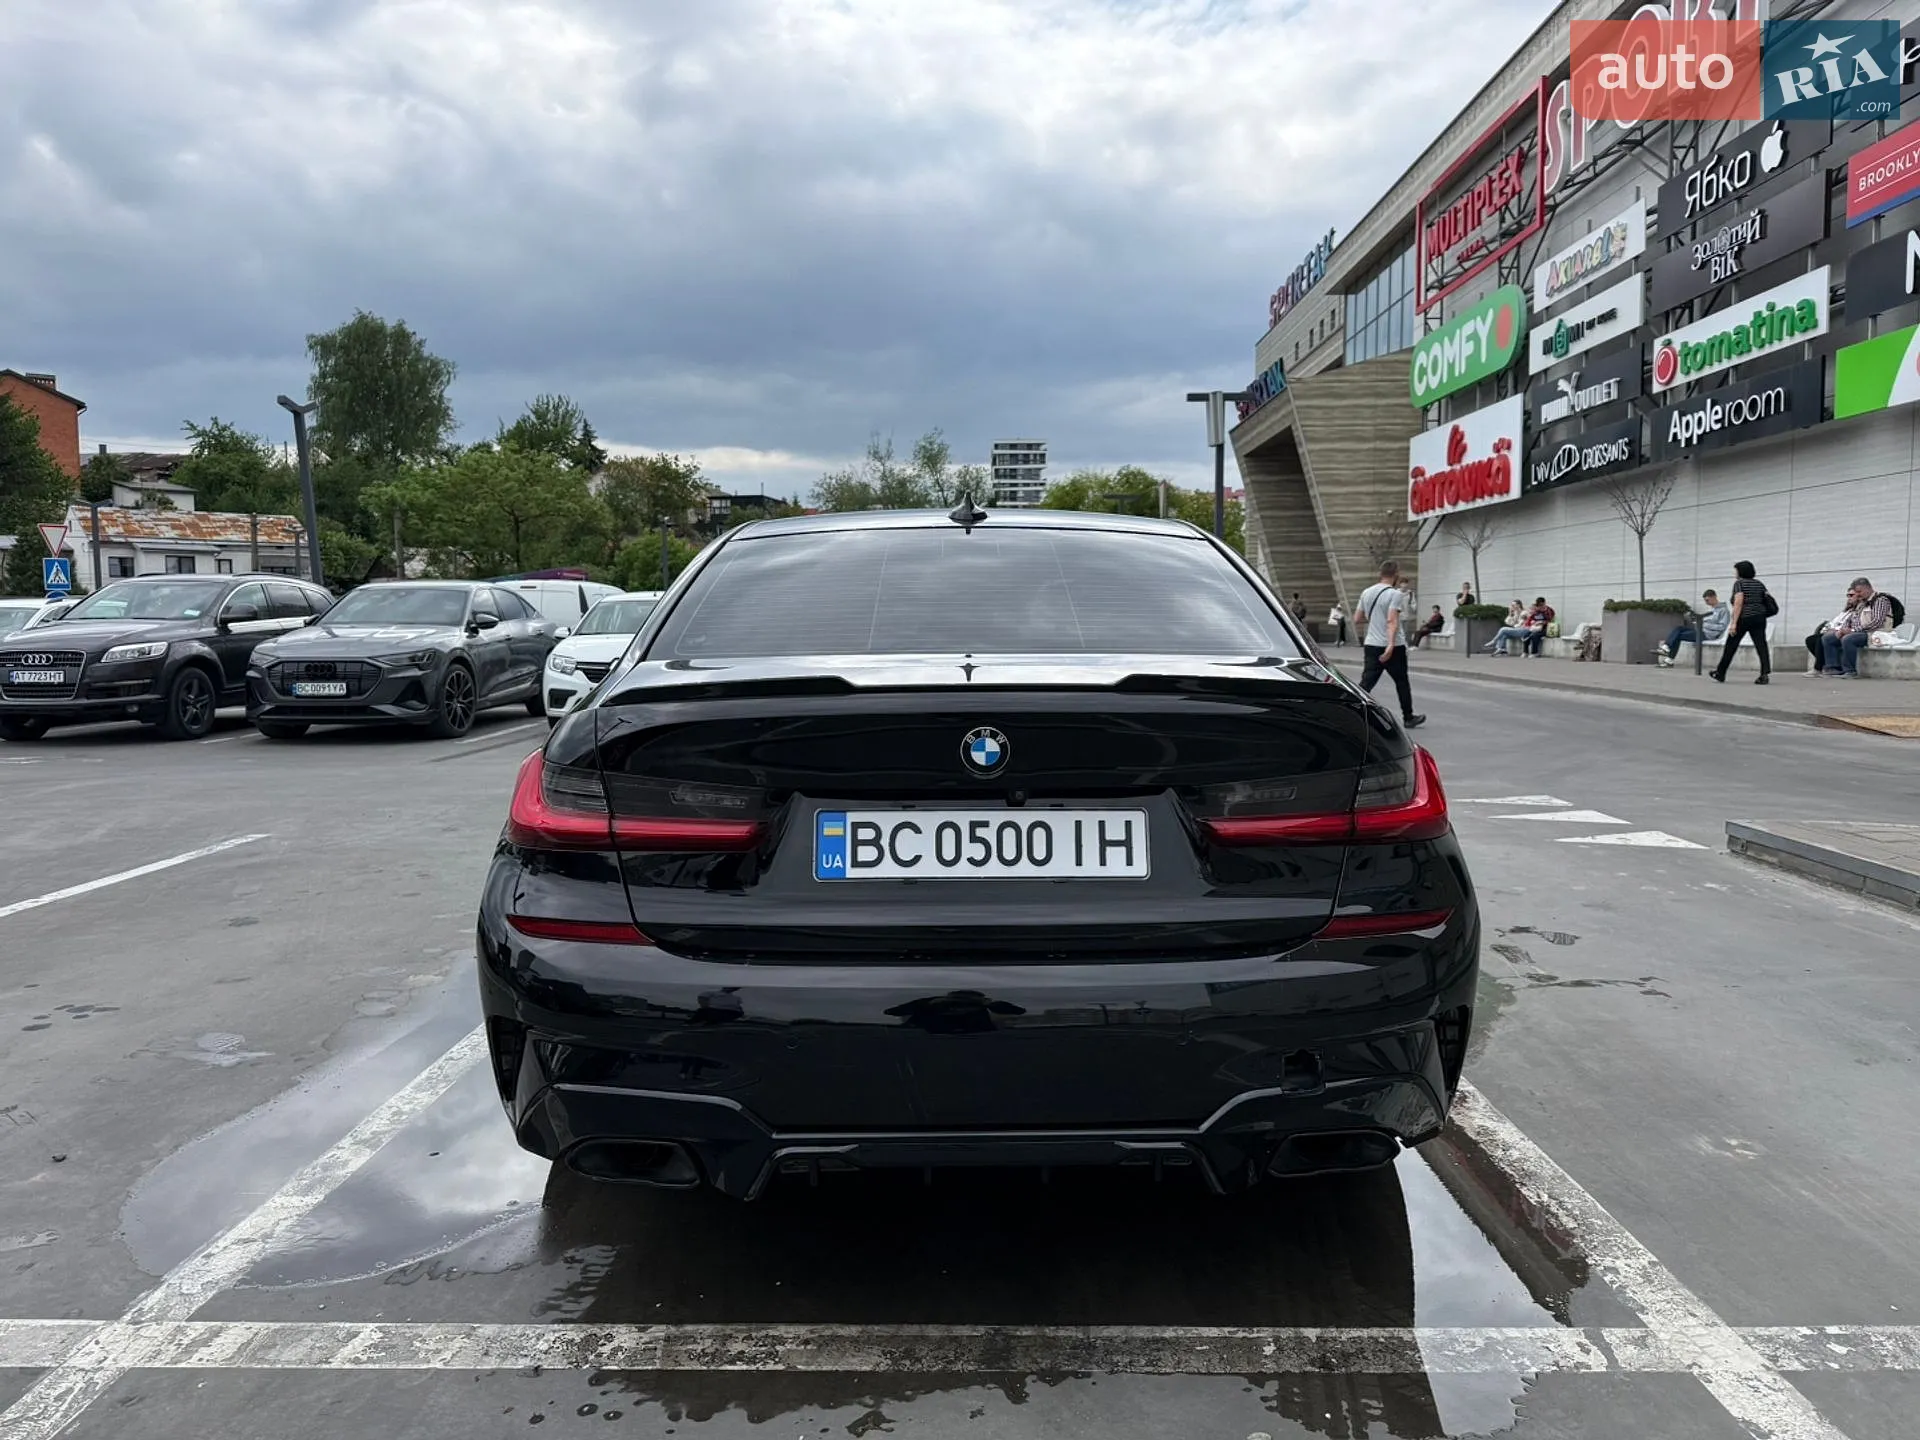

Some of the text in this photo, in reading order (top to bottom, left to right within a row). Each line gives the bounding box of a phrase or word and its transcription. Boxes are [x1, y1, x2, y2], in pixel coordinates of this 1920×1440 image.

[1427, 146, 1525, 264] MULTIPLEX
[1684, 151, 1752, 219] Ябко
[1414, 308, 1494, 397] COMFY
[1679, 297, 1818, 376] tomatina
[1668, 387, 1784, 448] Appleroom
[822, 854, 844, 869] UA
[850, 820, 1134, 868] BC 0500 IH
